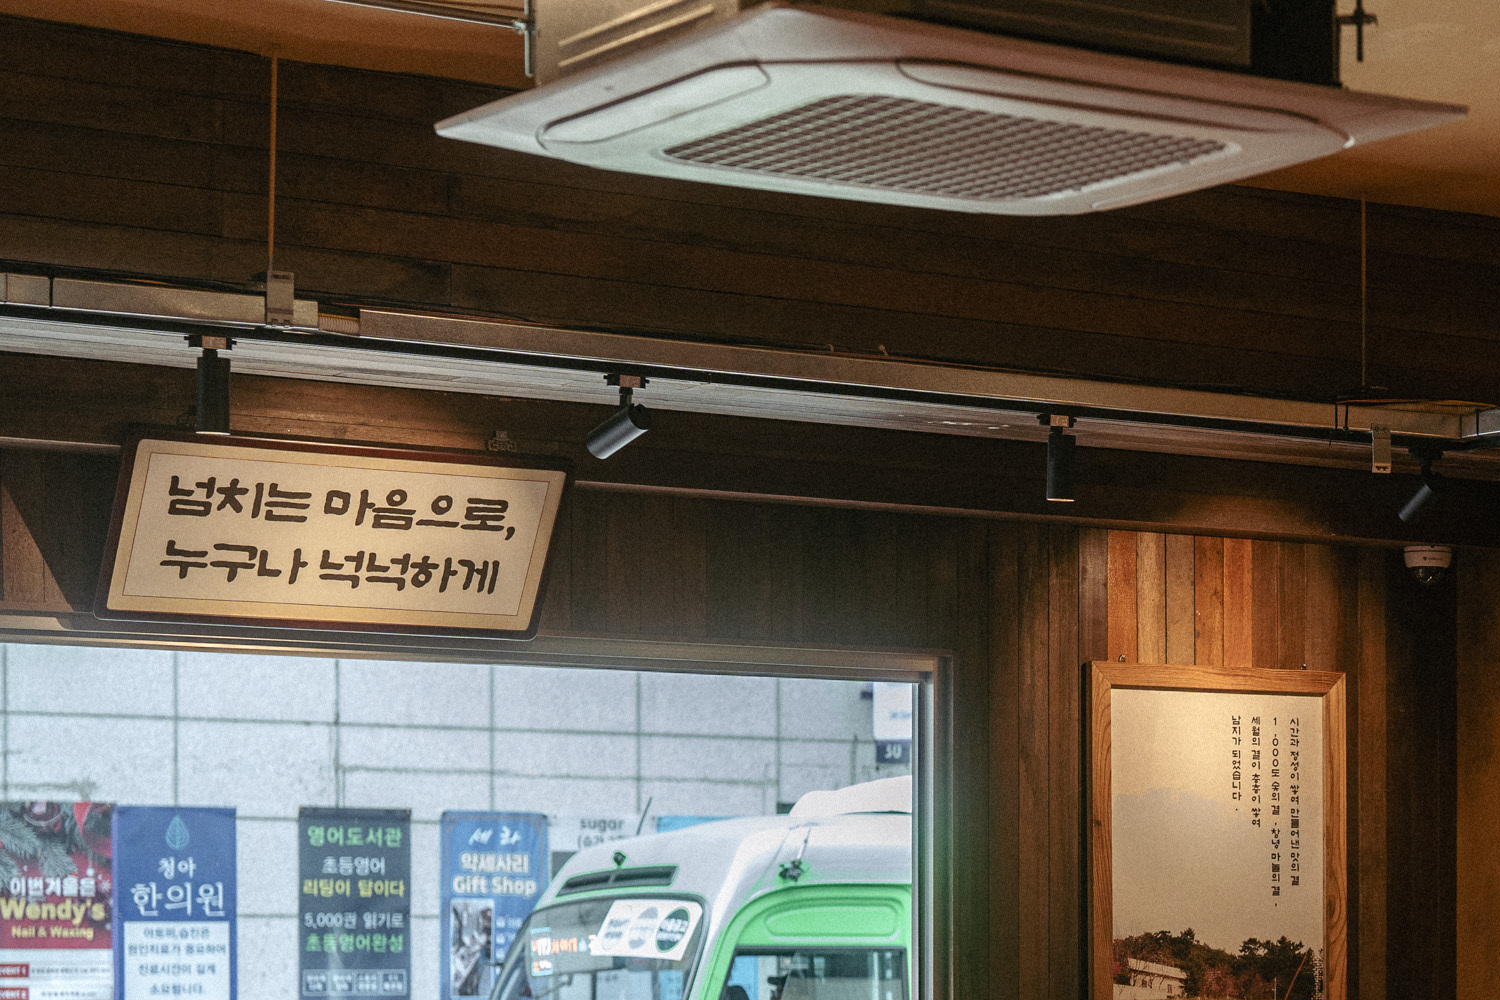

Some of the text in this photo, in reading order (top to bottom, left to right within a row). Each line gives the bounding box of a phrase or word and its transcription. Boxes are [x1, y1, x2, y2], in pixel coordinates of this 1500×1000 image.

[167, 475, 517, 541] 넘치는 마음으로,
[159, 539, 500, 595] 누구나 넉넉하게
[1271, 717, 1281, 778] 1,000도
[1231, 715, 1242, 812] 남지가 되었습니다.
[1251, 716, 1261, 828] 세월의 결이 층층이 쌓여
[1271, 781, 1281, 802] 숯의
[1290, 717, 1300, 886] 시간과 정성이 쌓여 만들어낸 맛의 결
[307, 825, 403, 848] 영어도서관
[580, 819, 625, 832] sugar
[1271, 827, 1281, 850] 창녕
[321, 855, 386, 876] 초등영어
[460, 852, 529, 874] 악세사리
[1271, 852, 1281, 882] 마늘의
[129, 881, 226, 917] 한의원
[303, 878, 406, 898] 리딩이 답이다
[452, 876, 537, 899] Gift Shop
[0, 896, 106, 927] Wendy's
[11, 925, 95, 941] Nail & Waxing
[304, 932, 404, 954] 초등영어완성
